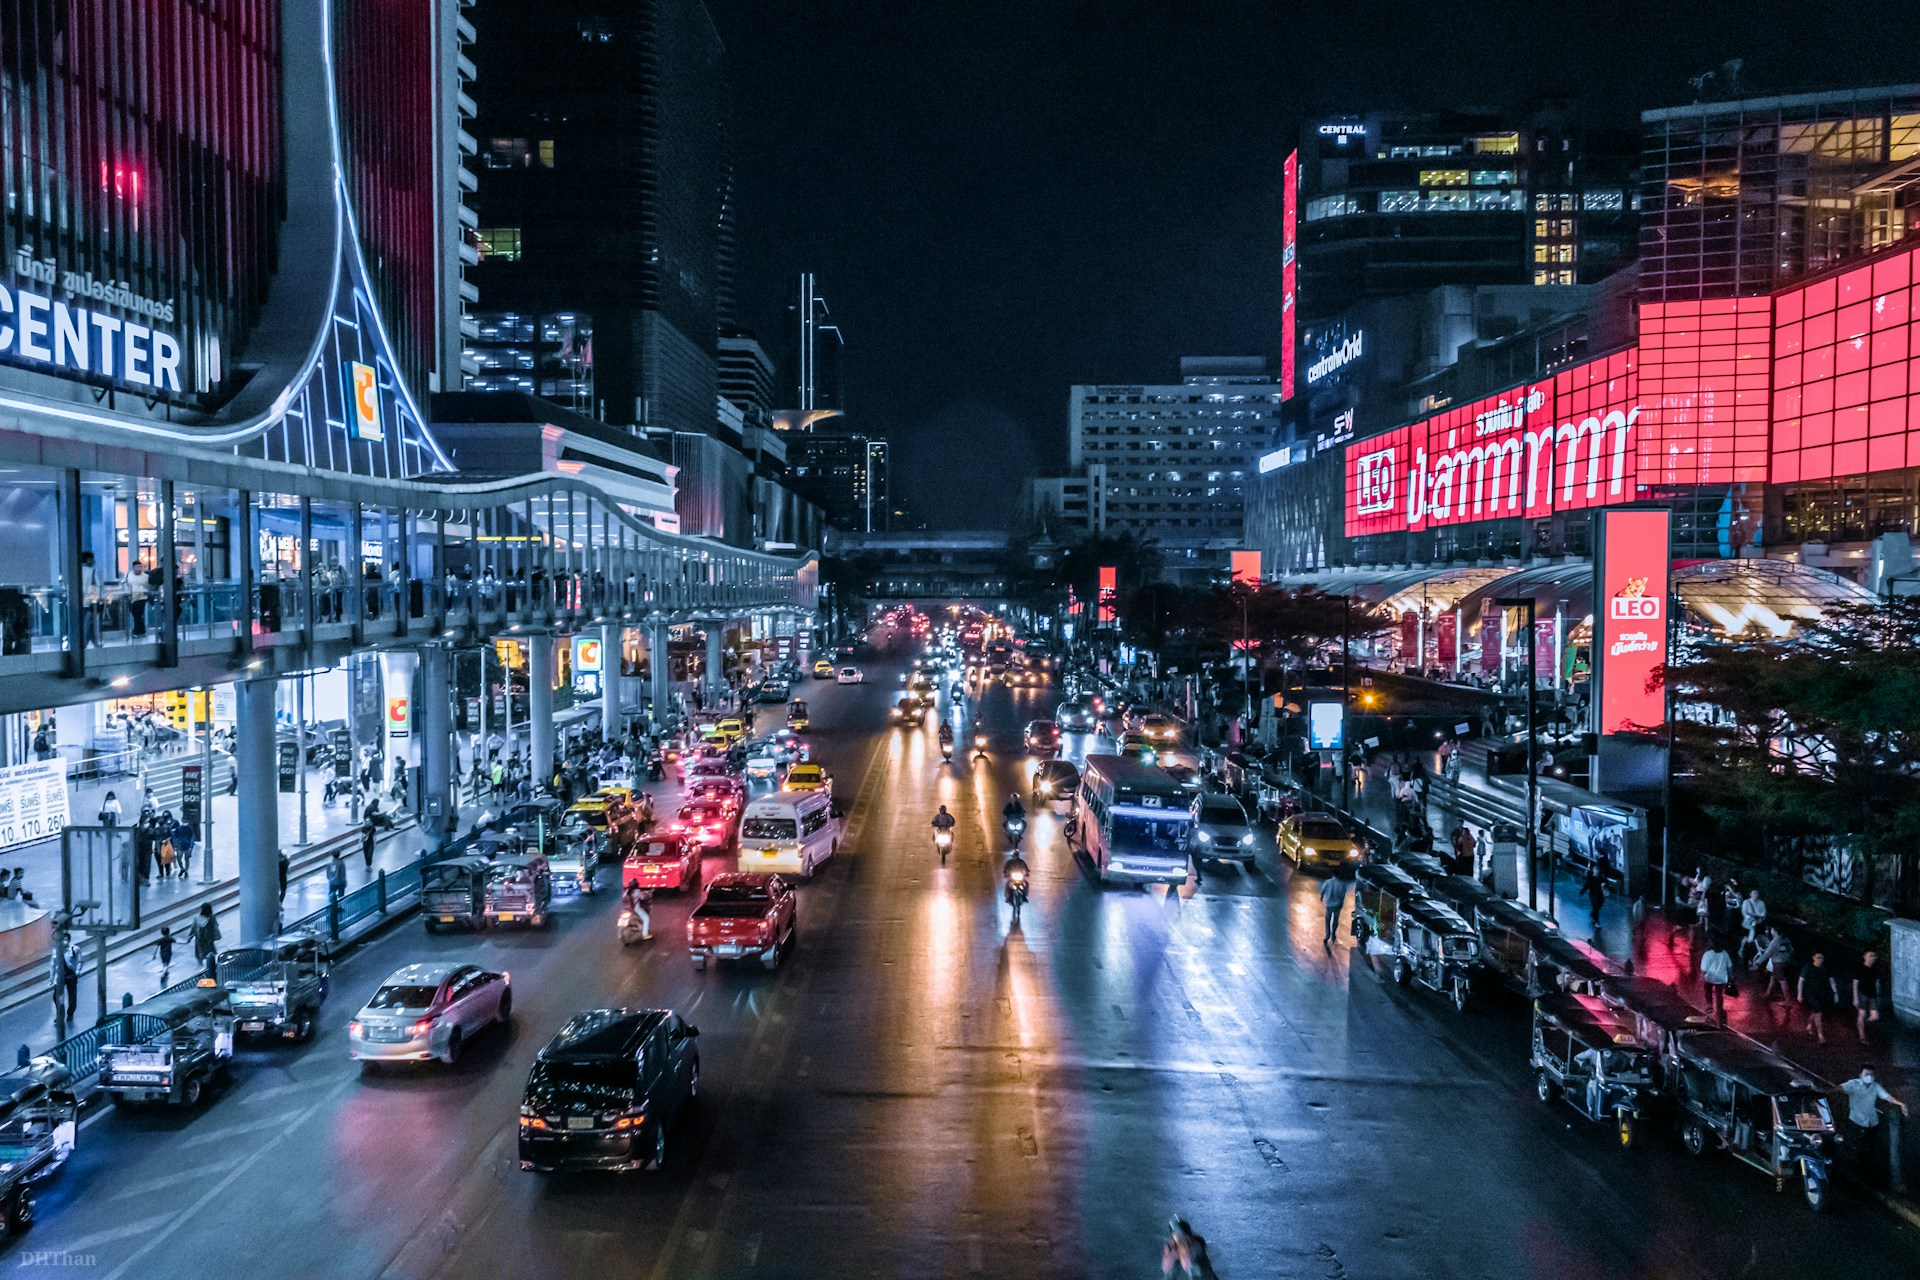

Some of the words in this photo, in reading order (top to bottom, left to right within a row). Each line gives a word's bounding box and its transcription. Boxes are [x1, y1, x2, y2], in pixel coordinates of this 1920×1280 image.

[1319, 125, 1366, 134] CENTRAL
[1615, 600, 1656, 616] LEO
[1144, 796, 1158, 805] 77
[22, 819, 40, 838] 170
[47, 814, 66, 833] 260
